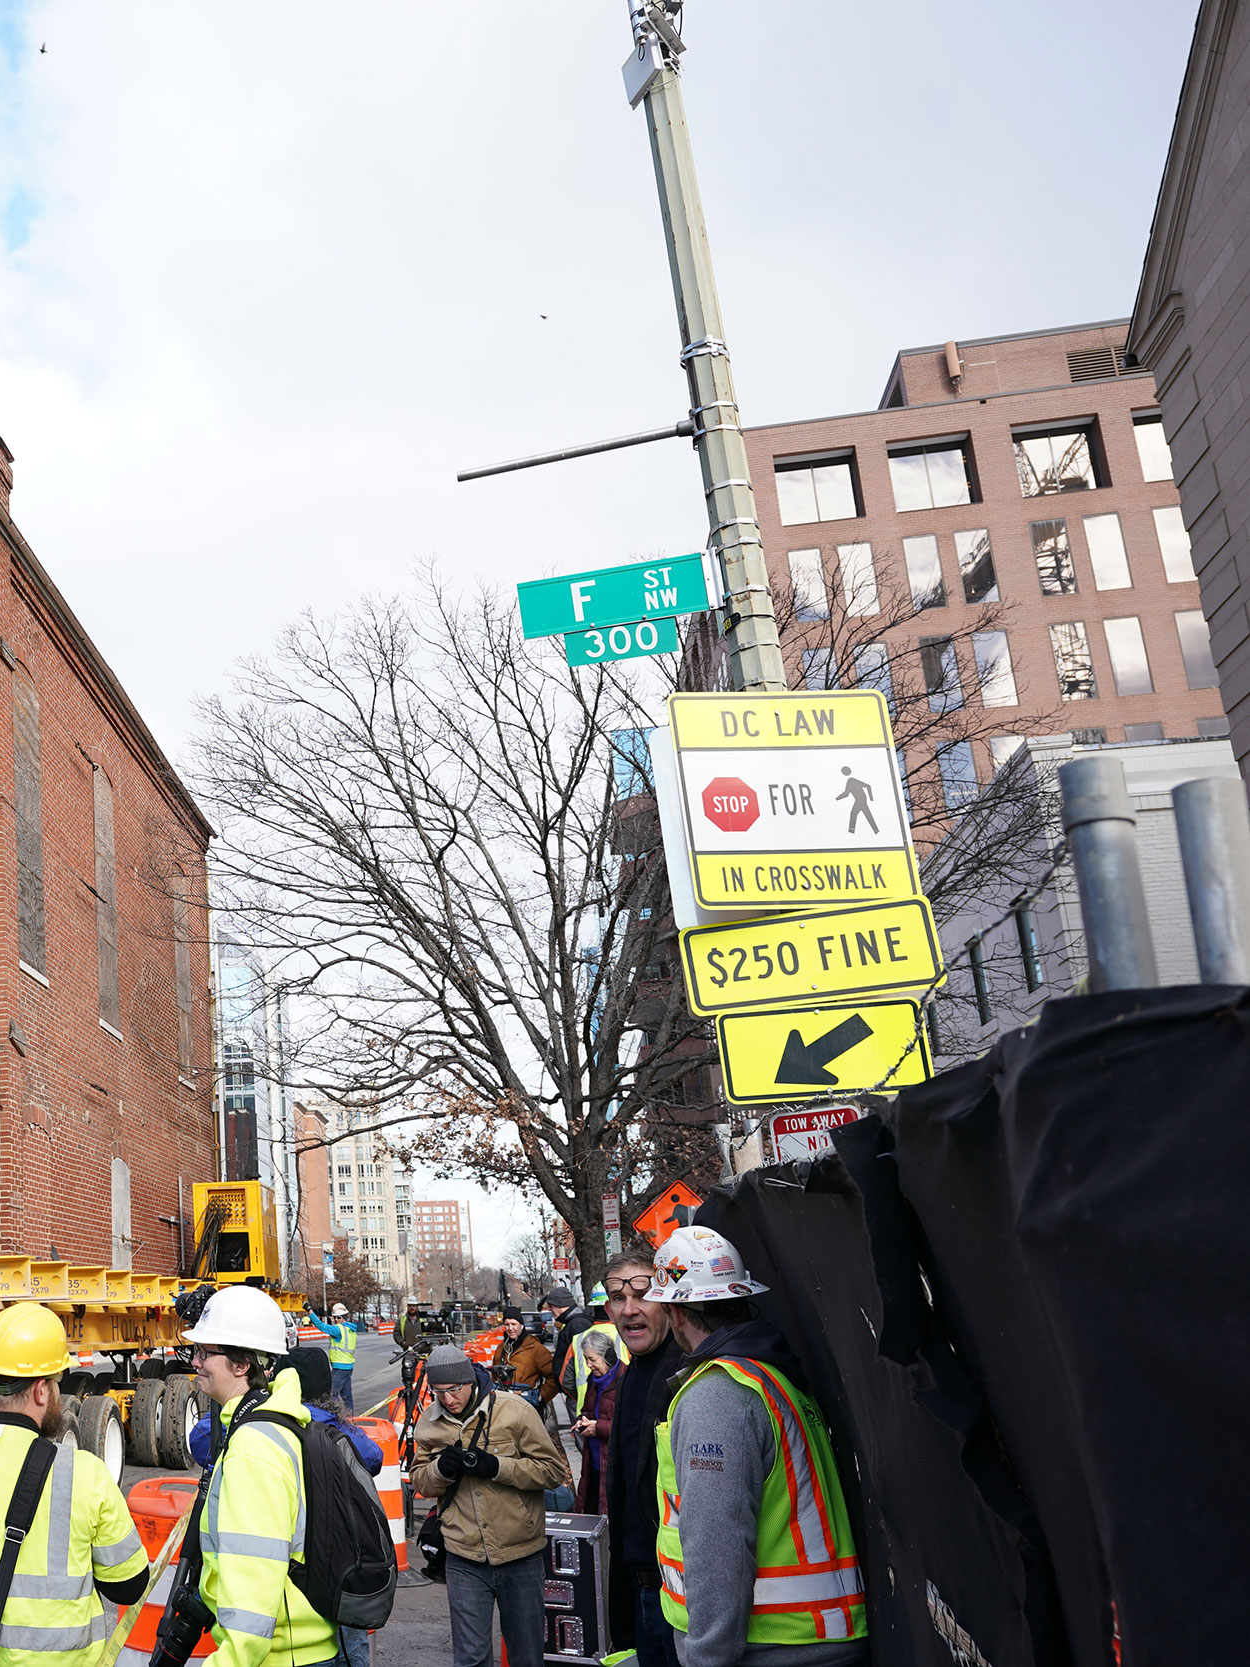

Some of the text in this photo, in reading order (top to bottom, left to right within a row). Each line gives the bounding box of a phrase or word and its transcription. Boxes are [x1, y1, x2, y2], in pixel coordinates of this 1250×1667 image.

[570, 567, 672, 622] F ST
[645, 587, 678, 610] NW
[584, 622, 658, 658] 300
[721, 709, 835, 737] DC LAW
[713, 784, 815, 816] STOP FOR
[722, 863, 887, 892] IN CROSSWALK
[706, 926, 908, 988] $250 FINE
[784, 1112, 845, 1131] TOW AWAY
[68, 1289, 89, 1297] 12X79
[234, 1399, 258, 1423] Canon
[691, 1443, 724, 1455] CLARK
